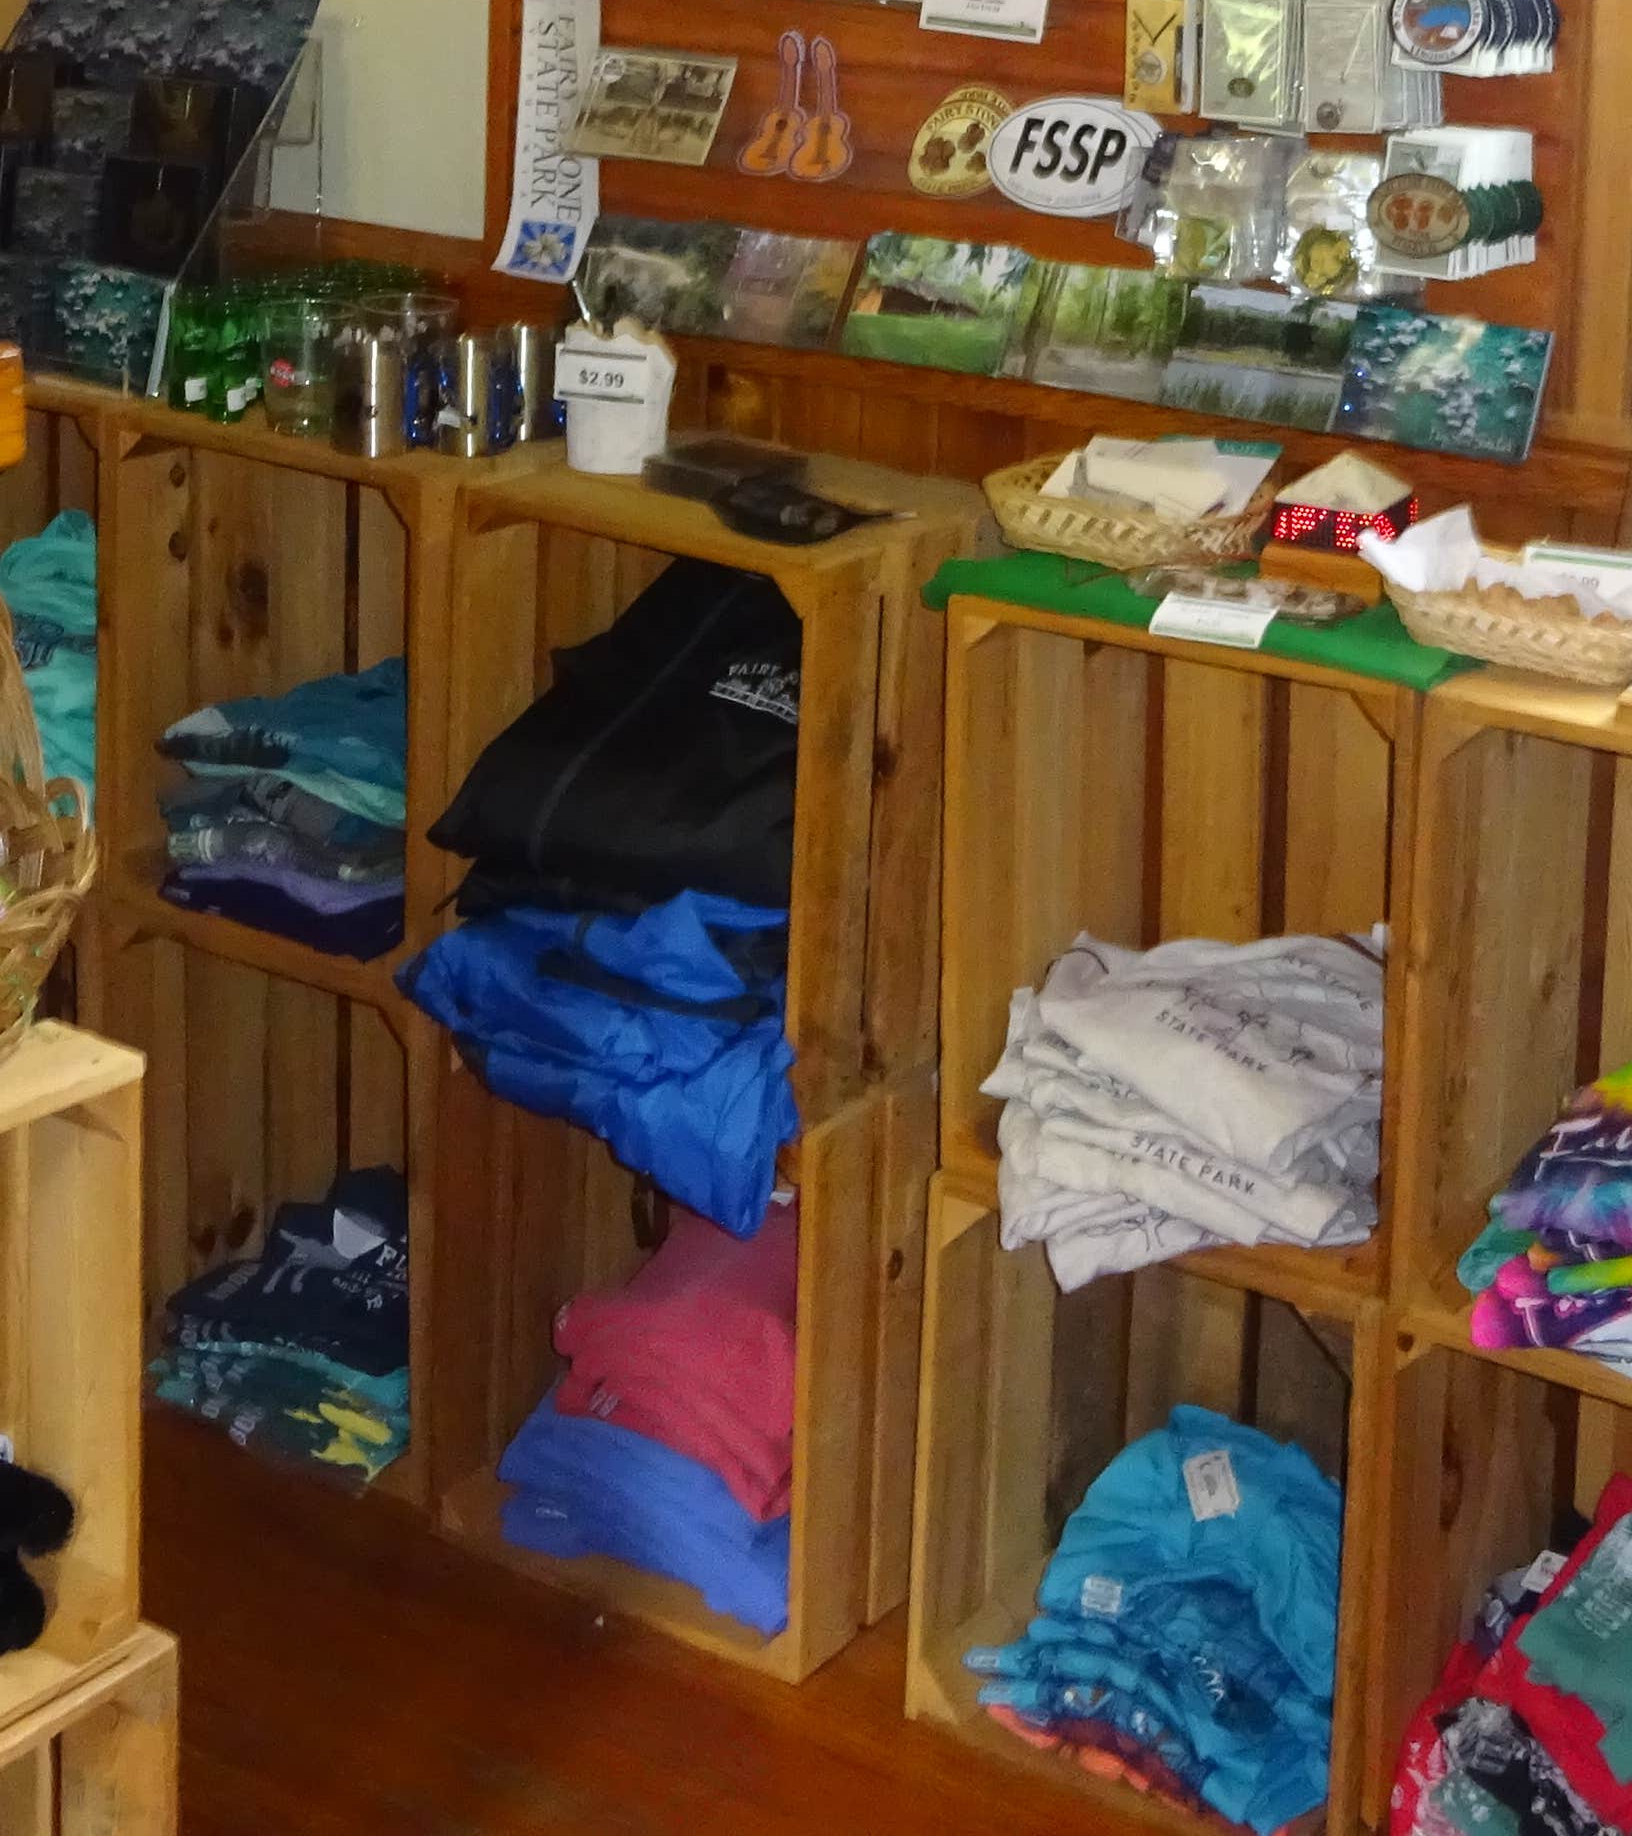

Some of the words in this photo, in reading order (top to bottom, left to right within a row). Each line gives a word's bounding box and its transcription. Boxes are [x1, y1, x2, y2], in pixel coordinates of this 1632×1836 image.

[536, 21, 558, 117] STATE
[531, 127, 557, 207] PARK
[1009, 117, 1127, 185] FSSP
[578, 369, 624, 389] $2.99
[1156, 1010, 1209, 1042] STATE
[1131, 1134, 1189, 1173] STATE
[1198, 1163, 1255, 1195] PARK
